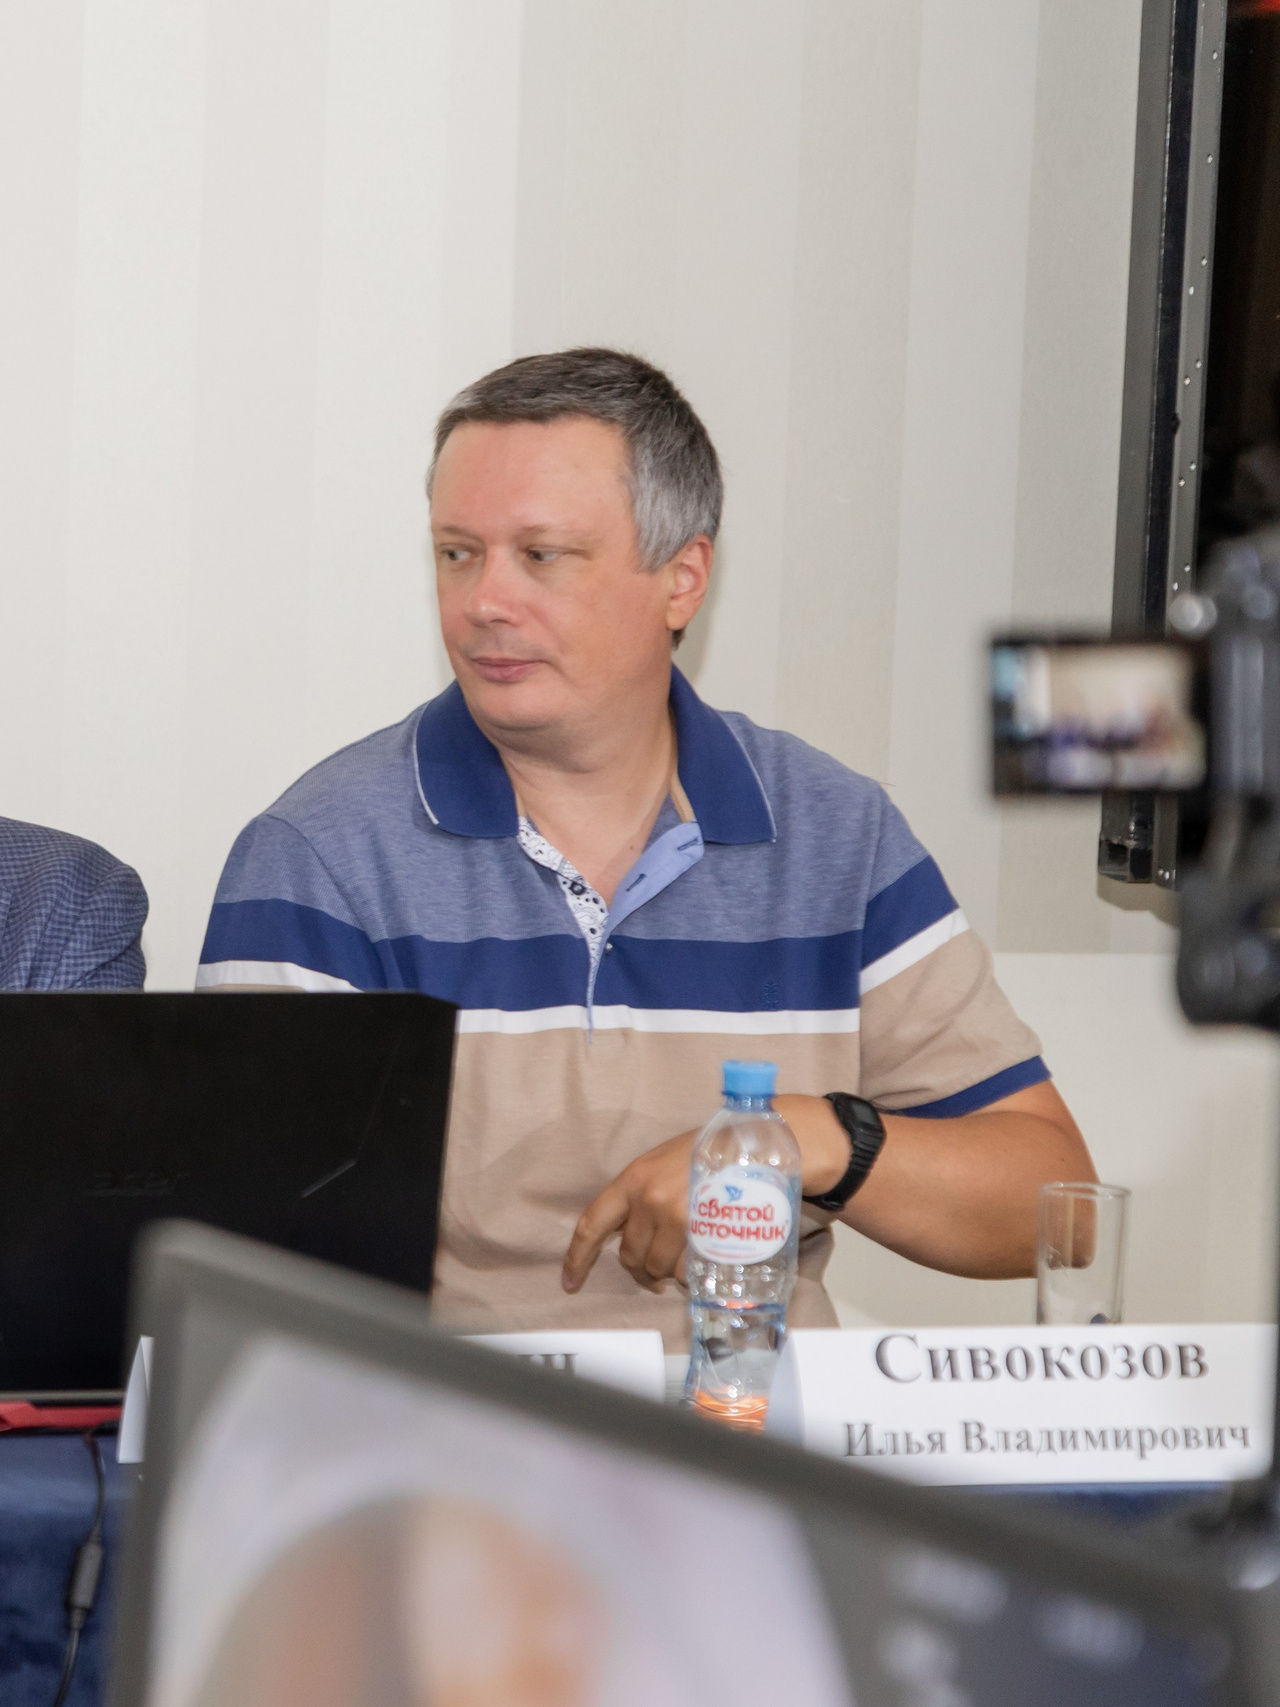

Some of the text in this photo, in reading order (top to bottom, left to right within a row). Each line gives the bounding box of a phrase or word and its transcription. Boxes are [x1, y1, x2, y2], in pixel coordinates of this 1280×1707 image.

[873, 1334, 1210, 1384] Сивокозов
[843, 1420, 1252, 1459] Илья Владимирович
